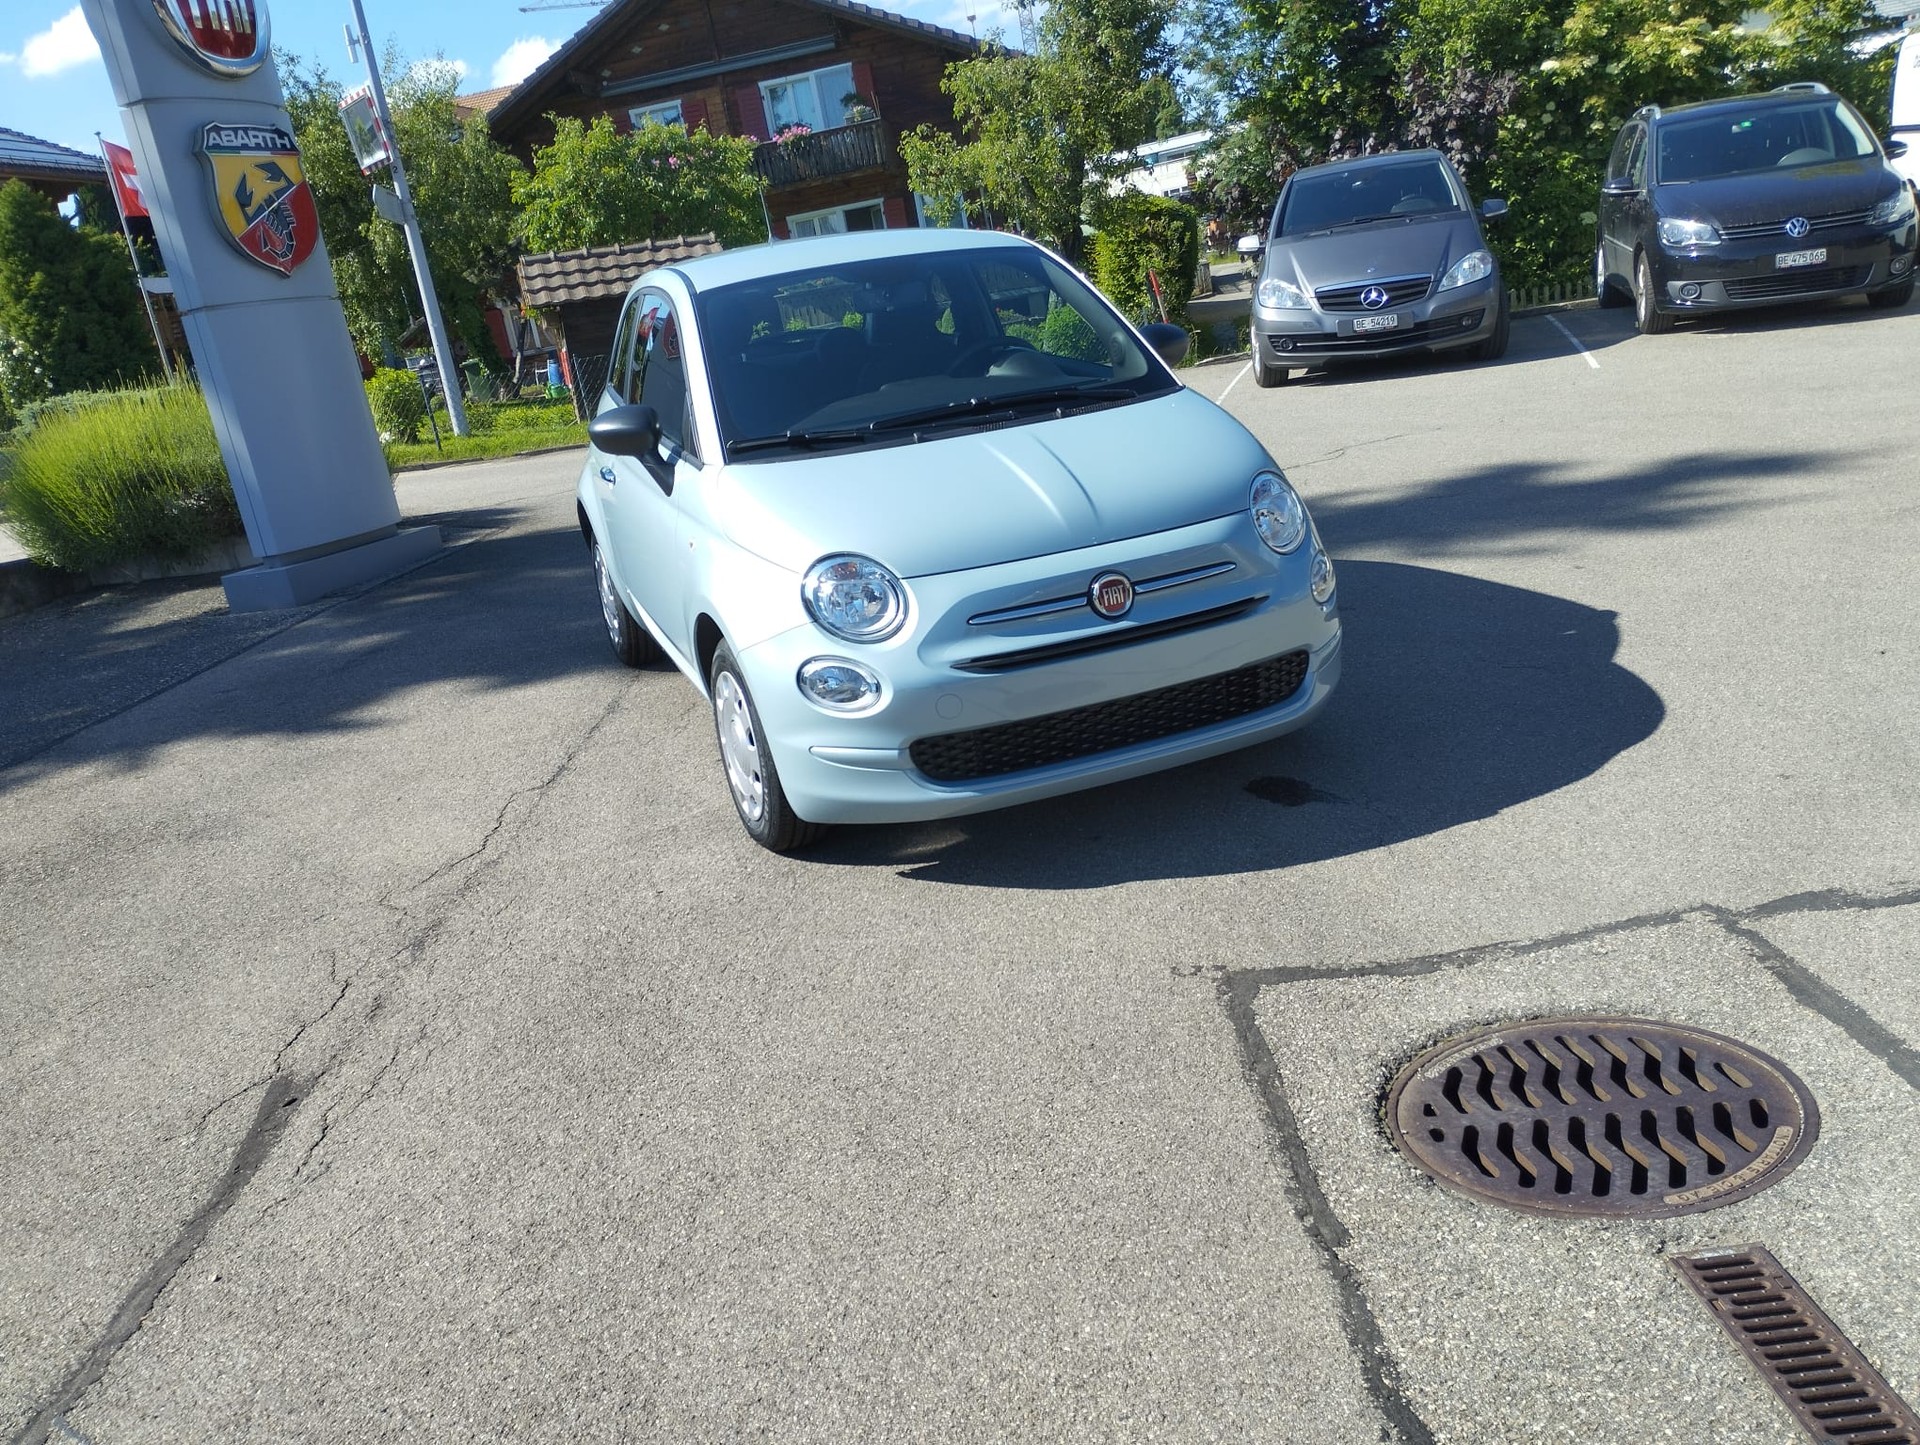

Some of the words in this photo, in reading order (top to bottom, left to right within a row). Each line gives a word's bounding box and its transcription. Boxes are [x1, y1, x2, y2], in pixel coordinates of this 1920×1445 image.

[208, 130, 291, 148] ABARTH
[1778, 256, 1789, 265] BE
[1356, 320, 1366, 328] BE
[1102, 585, 1124, 606] FIAT
[1677, 1190, 1701, 1202] AG
